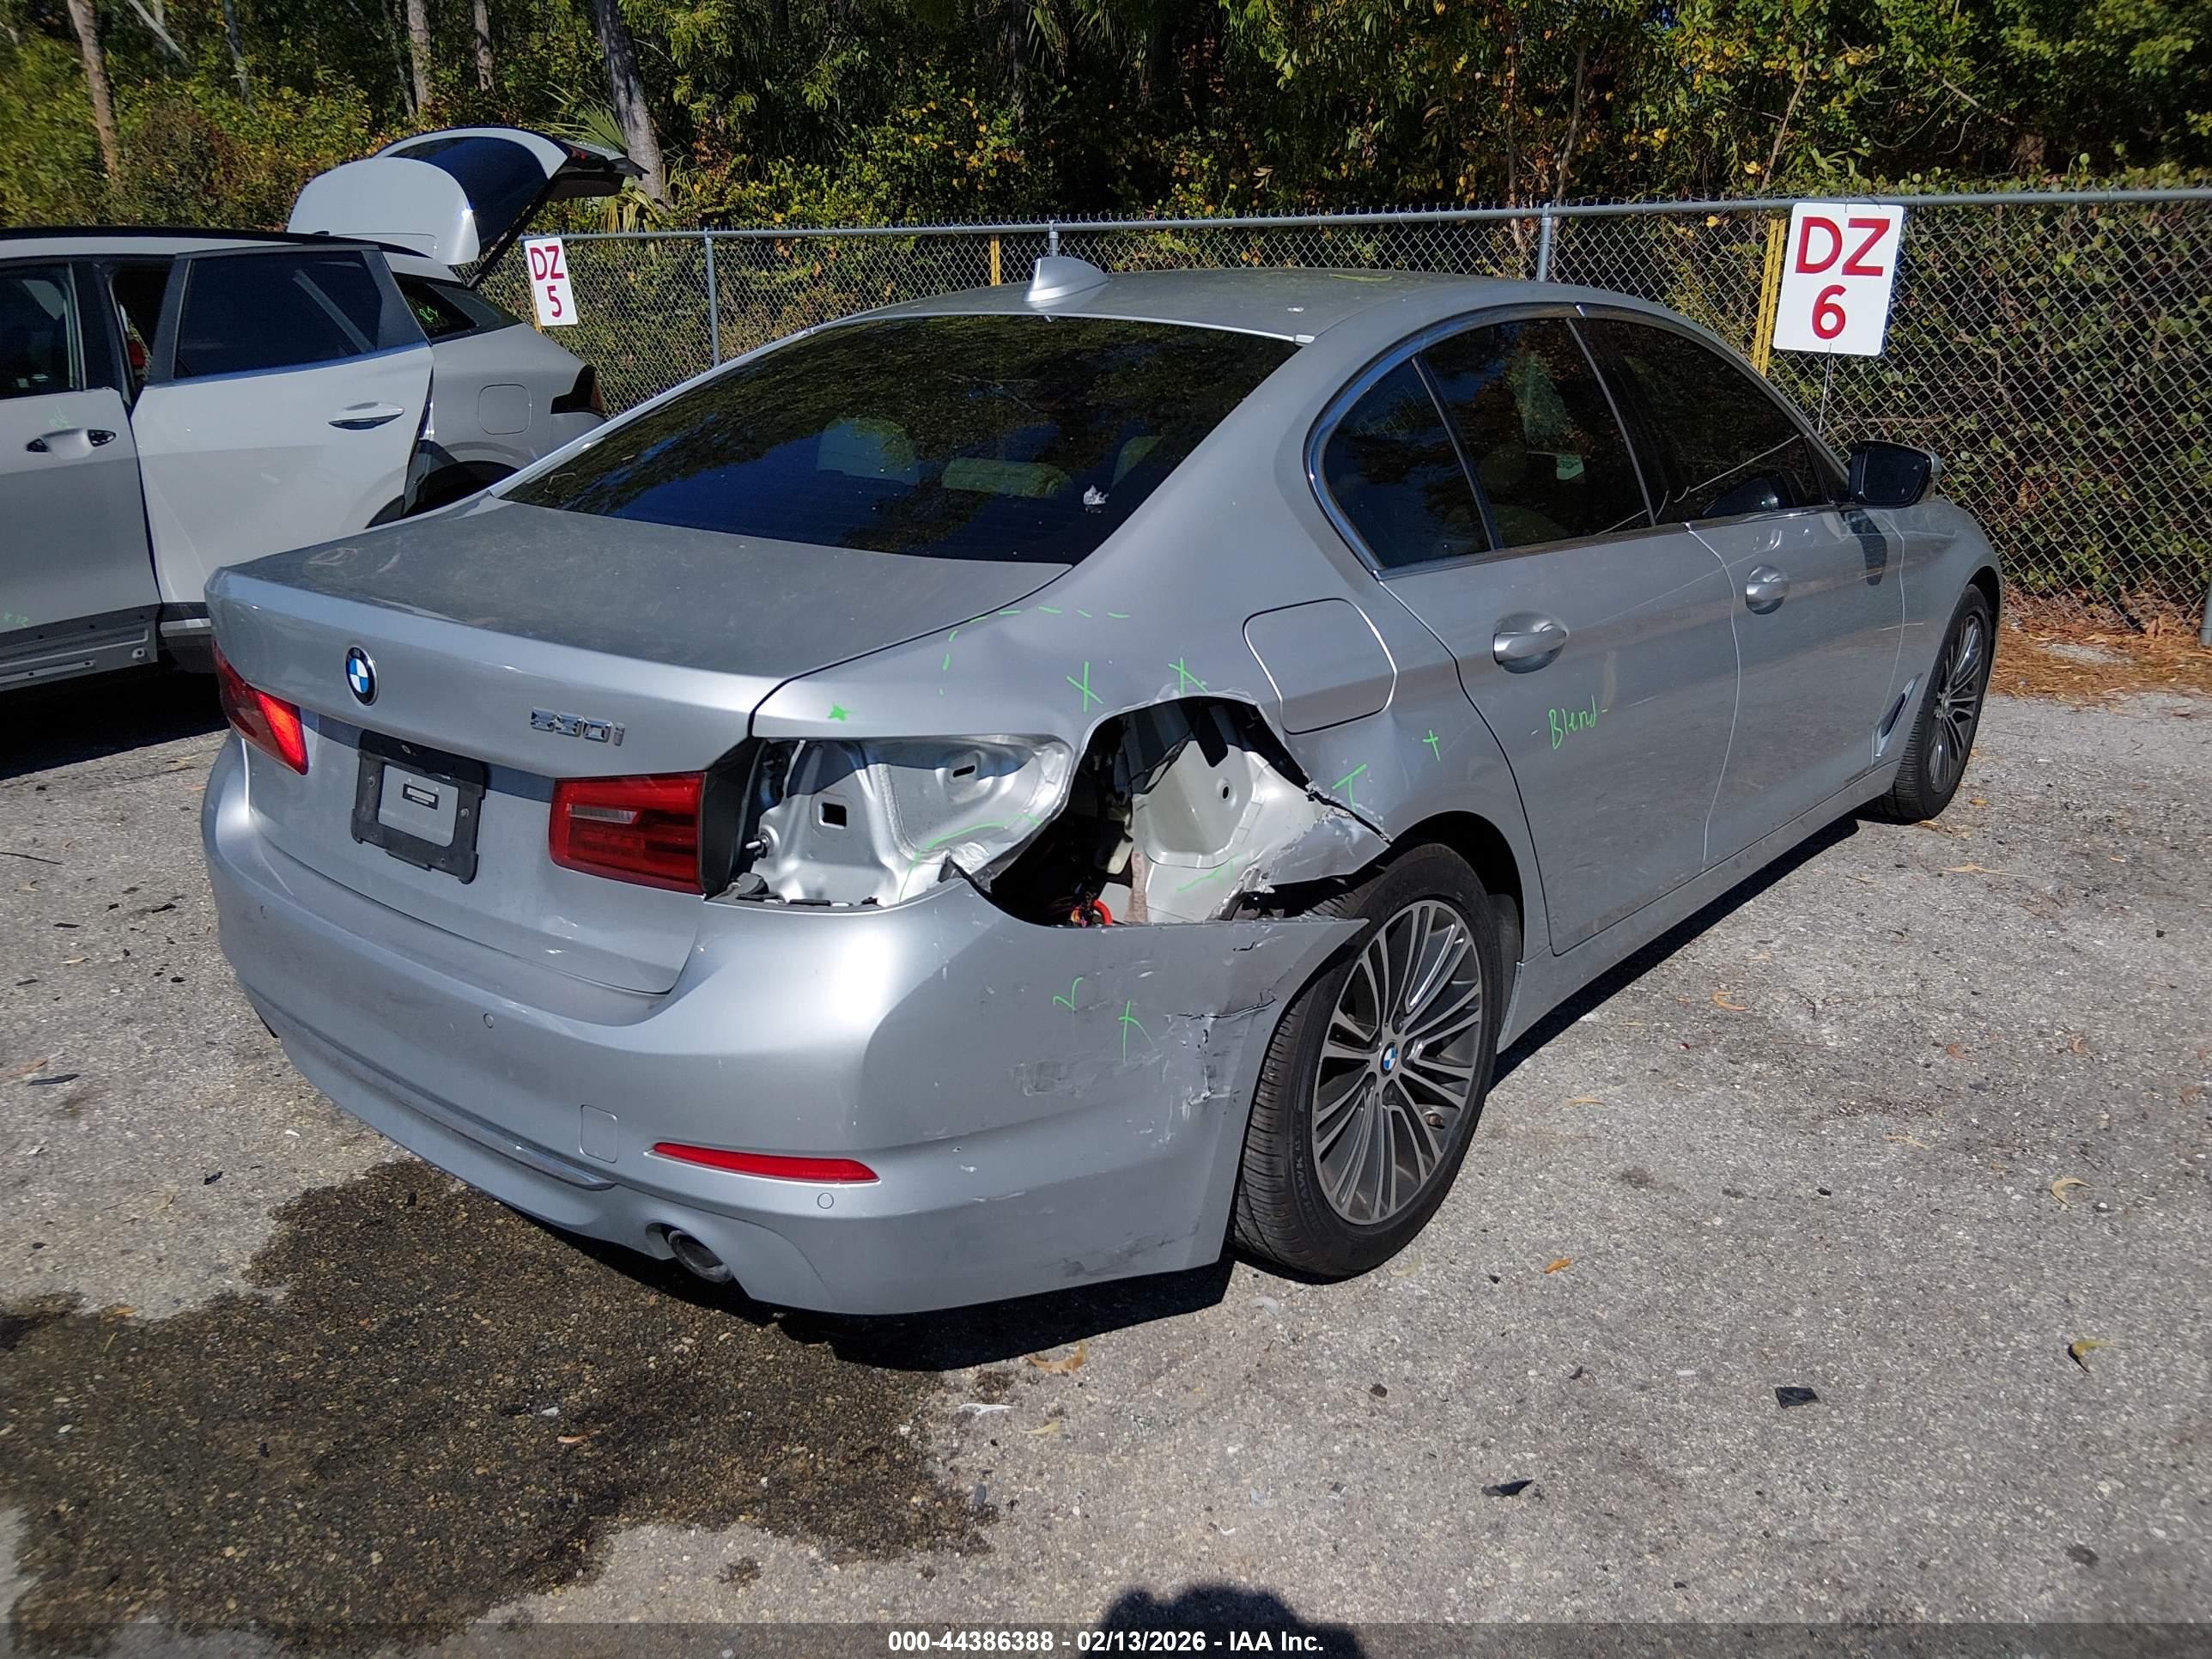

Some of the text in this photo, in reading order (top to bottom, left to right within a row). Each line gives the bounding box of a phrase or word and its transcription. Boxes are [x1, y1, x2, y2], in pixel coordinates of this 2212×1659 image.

[529, 245, 565, 281] DZ
[1795, 216, 1891, 277] DZ
[546, 284, 562, 318] 5
[1811, 284, 1847, 340] 6
